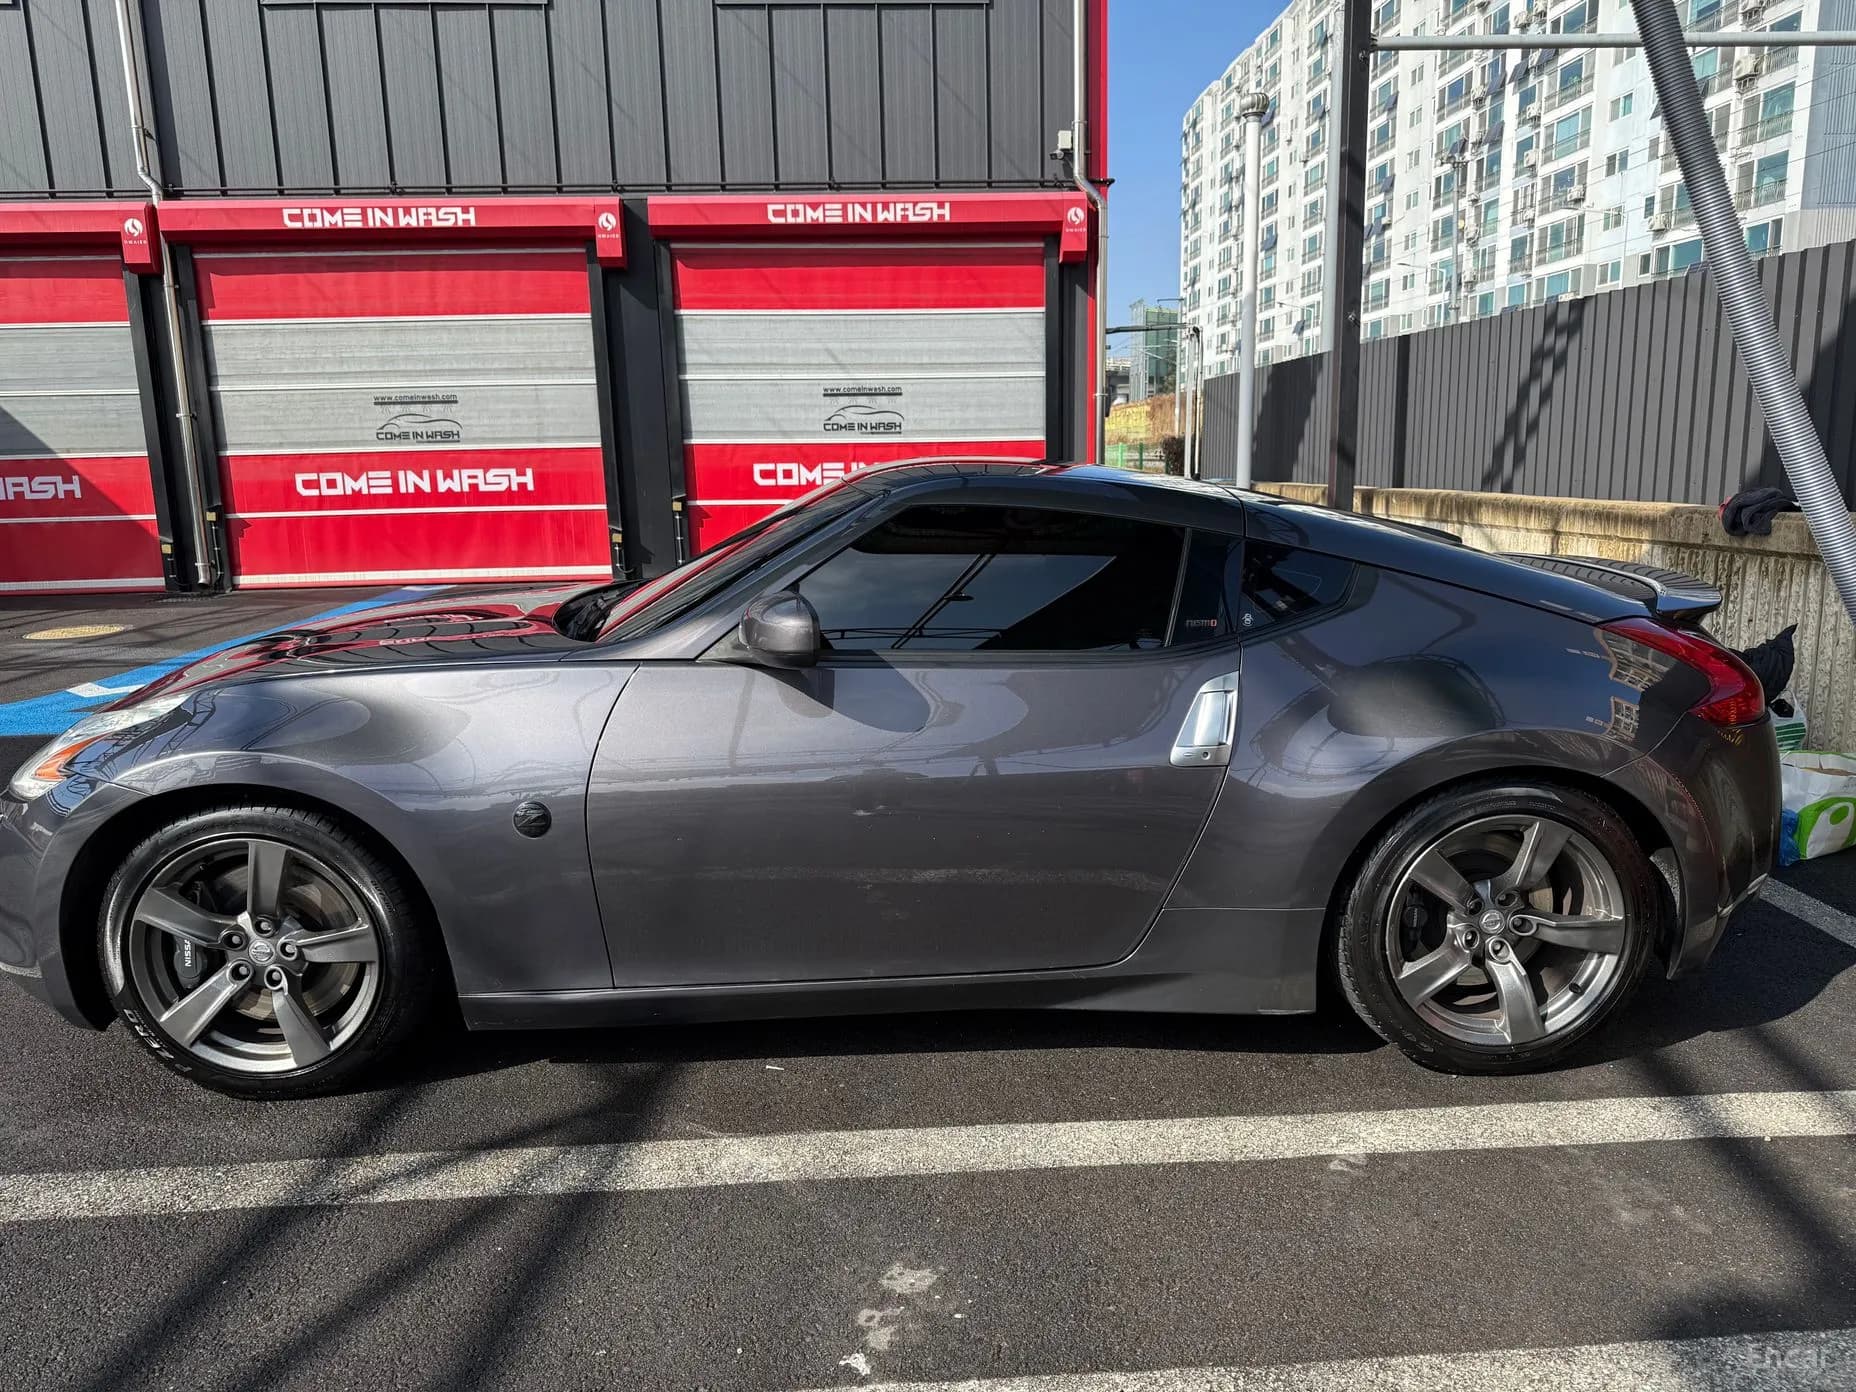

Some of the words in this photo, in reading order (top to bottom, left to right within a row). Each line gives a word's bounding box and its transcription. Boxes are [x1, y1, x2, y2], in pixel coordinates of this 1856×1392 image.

[282, 208, 362, 228] COME
[367, 207, 394, 227] IN
[398, 207, 477, 227] WASH
[767, 203, 843, 224] COME
[847, 203, 873, 223] IN
[876, 202, 951, 223] WASH
[373, 393, 458, 401] www.comeinwash.com
[822, 385, 902, 393] www.comeinwash.com
[376, 431, 411, 441] COME
[412, 431, 424, 440] IN
[426, 430, 460, 440] WASH
[823, 422, 856, 432] COME
[857, 422, 868, 431] IN
[870, 422, 902, 431] WASH
[295, 470, 393, 496] COME
[397, 469, 432, 494] IN
[436, 468, 535, 493] WASH
[752, 461, 845, 486] COME
[0, 475, 82, 500] ASH
[184, 939, 192, 967] NISSA
[123, 1008, 175, 1060] ZERO
